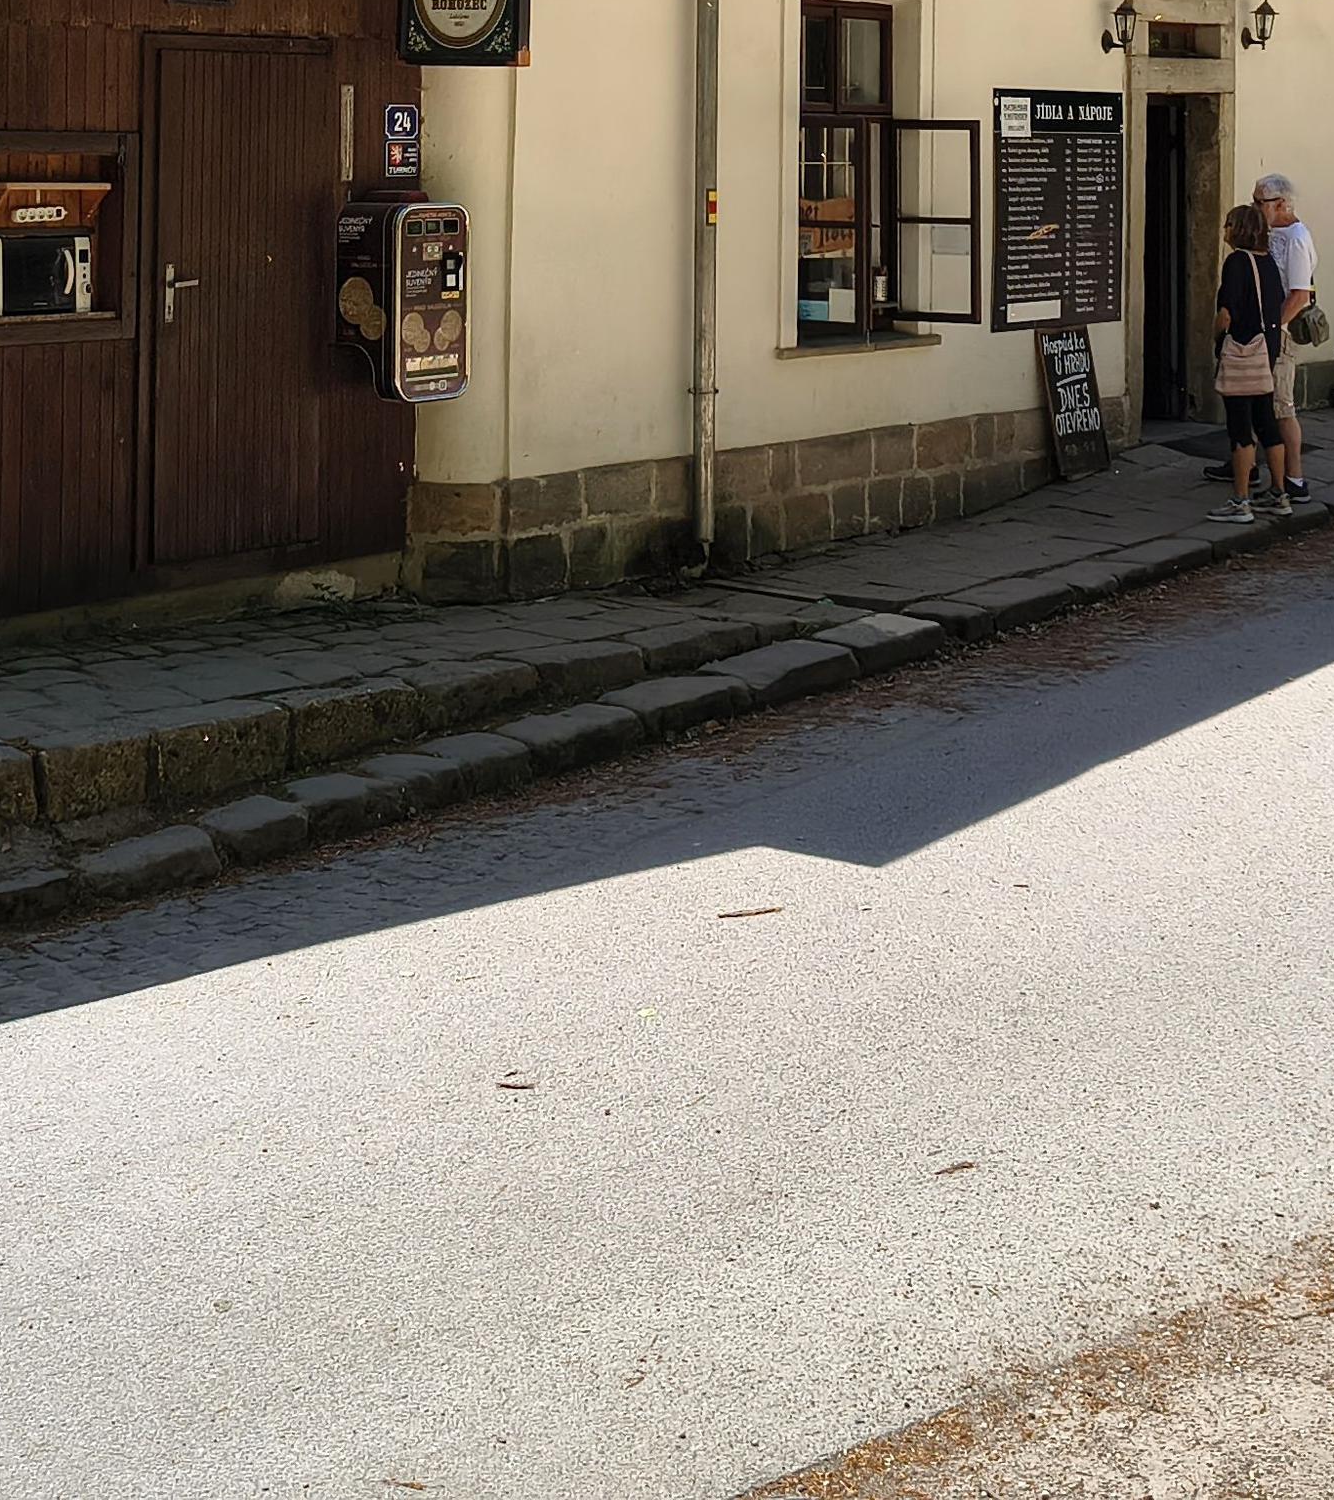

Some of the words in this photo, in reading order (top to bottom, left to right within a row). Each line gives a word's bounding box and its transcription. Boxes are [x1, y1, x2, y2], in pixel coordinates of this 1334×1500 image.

[394, 111, 411, 132] 24
[1034, 102, 1064, 120] JÍDLA
[1067, 104, 1074, 121] A
[1078, 103, 1113, 121] NÁPOJE
[1054, 356, 1062, 376] U
[1063, 352, 1090, 375] HRADU
[1057, 381, 1091, 413] DNES
